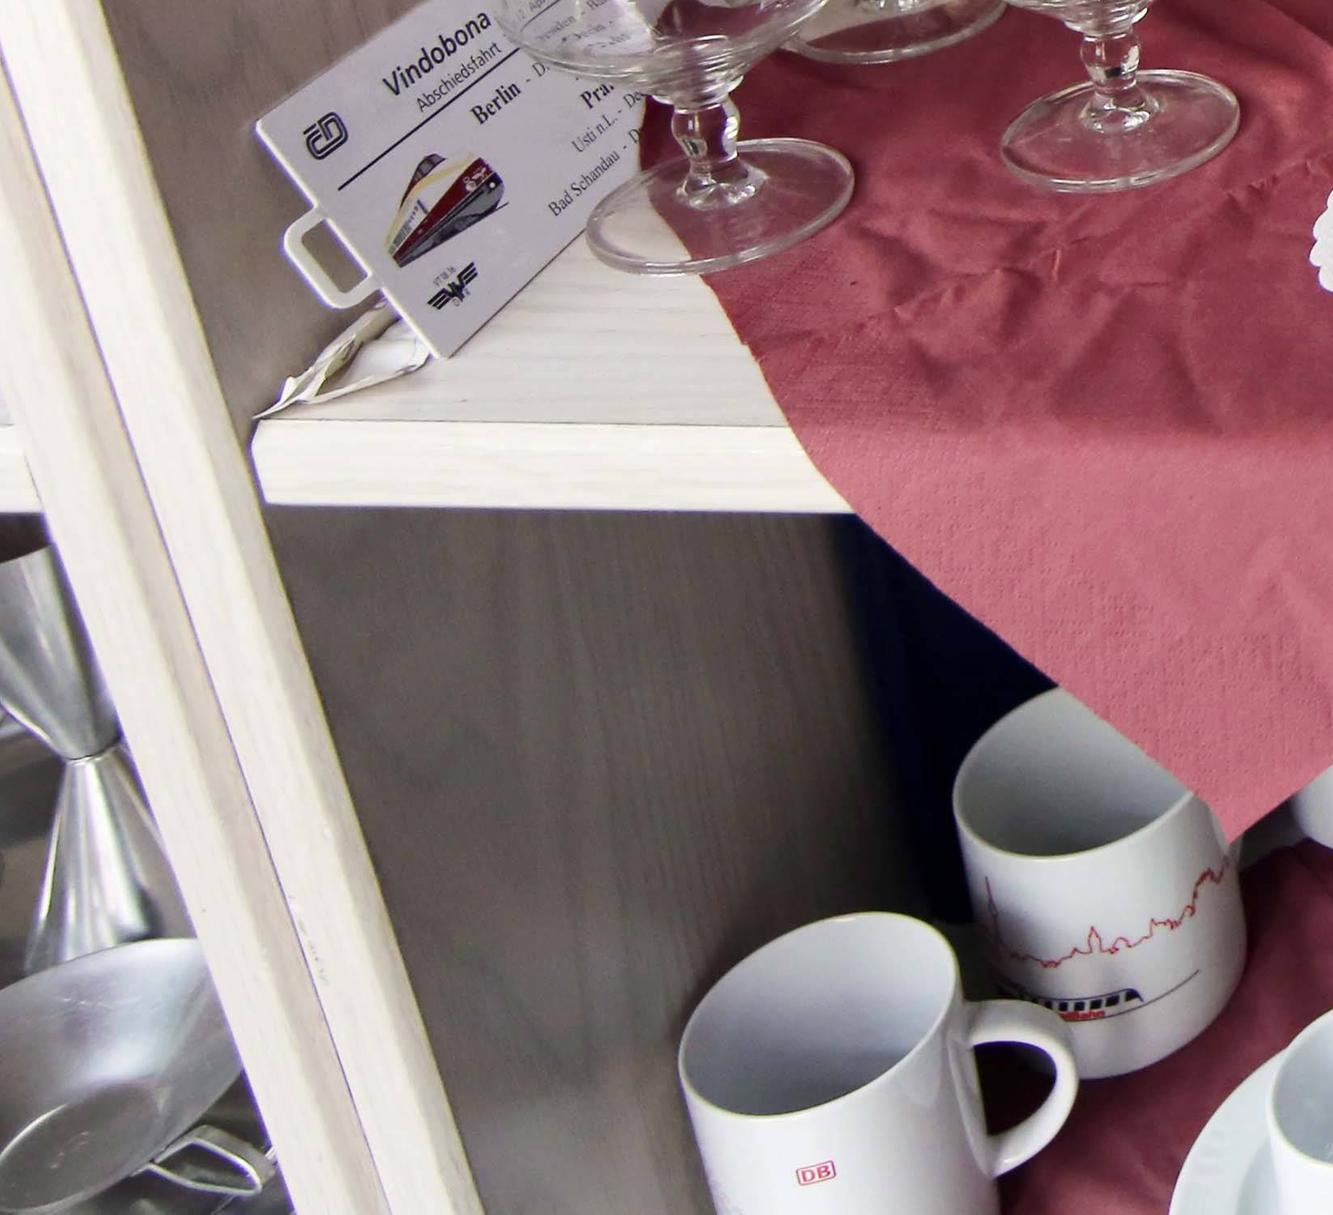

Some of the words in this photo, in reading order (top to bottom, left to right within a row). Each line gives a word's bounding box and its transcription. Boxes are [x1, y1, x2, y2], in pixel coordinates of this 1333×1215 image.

[382, 12, 492, 96] Vindobona
[416, 42, 502, 112] Abschiedsfahrt
[470, 83, 521, 125] Berlin
[548, 190, 573, 217] Bad
[571, 150, 620, 197] Schandau
[798, 1162, 834, 1184] DB
